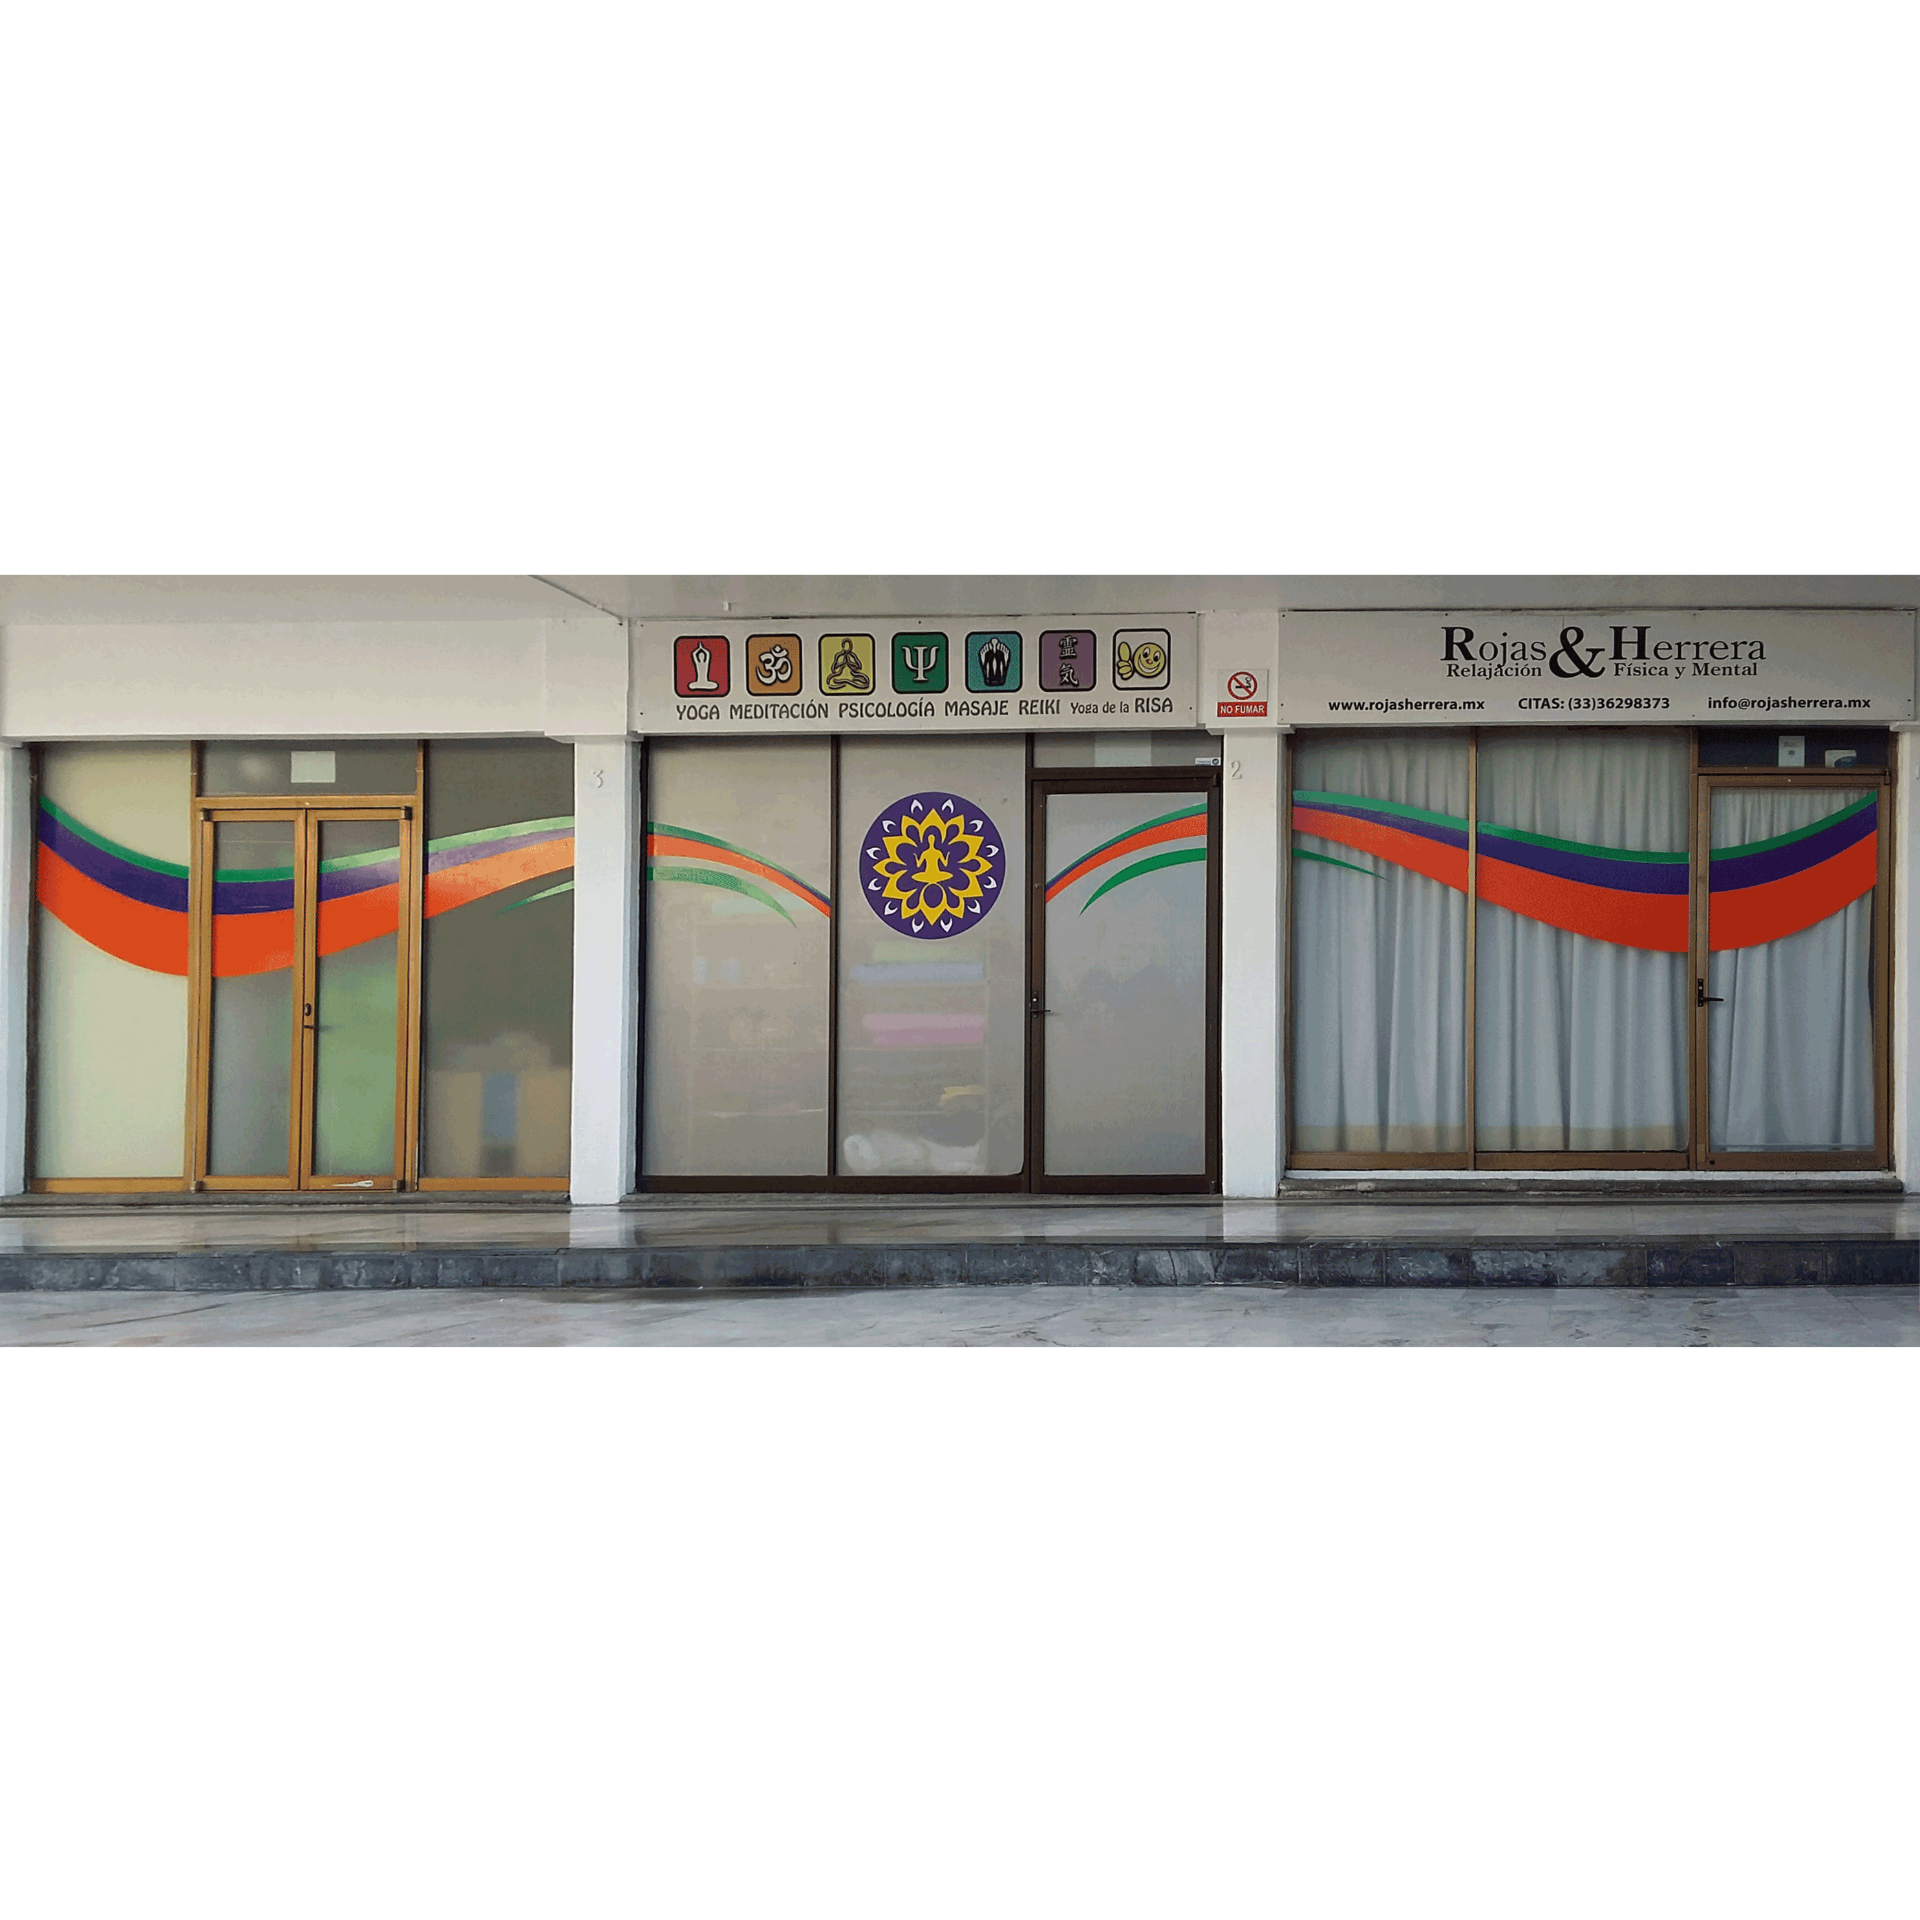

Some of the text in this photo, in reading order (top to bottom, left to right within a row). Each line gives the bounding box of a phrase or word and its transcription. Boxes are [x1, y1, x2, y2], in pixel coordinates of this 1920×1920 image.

[1440, 625, 1766, 678] Rojas & Herrera
[1446, 661, 1758, 680] Relajación Física y Mental
[676, 697, 1174, 720] YOGA MEDITACIÓN PSICOLOGÍA MASAJE REIKI Yoga de la RISA
[1220, 705, 1265, 714] NO FUMAR
[1328, 698, 1486, 714] www.rojasherrera.mx
[1518, 697, 1670, 711] CITAS: (33)36298373
[1707, 696, 1872, 712] info@rojasherrera.mx
[592, 769, 604, 789] 3
[1231, 760, 1242, 780] 2
